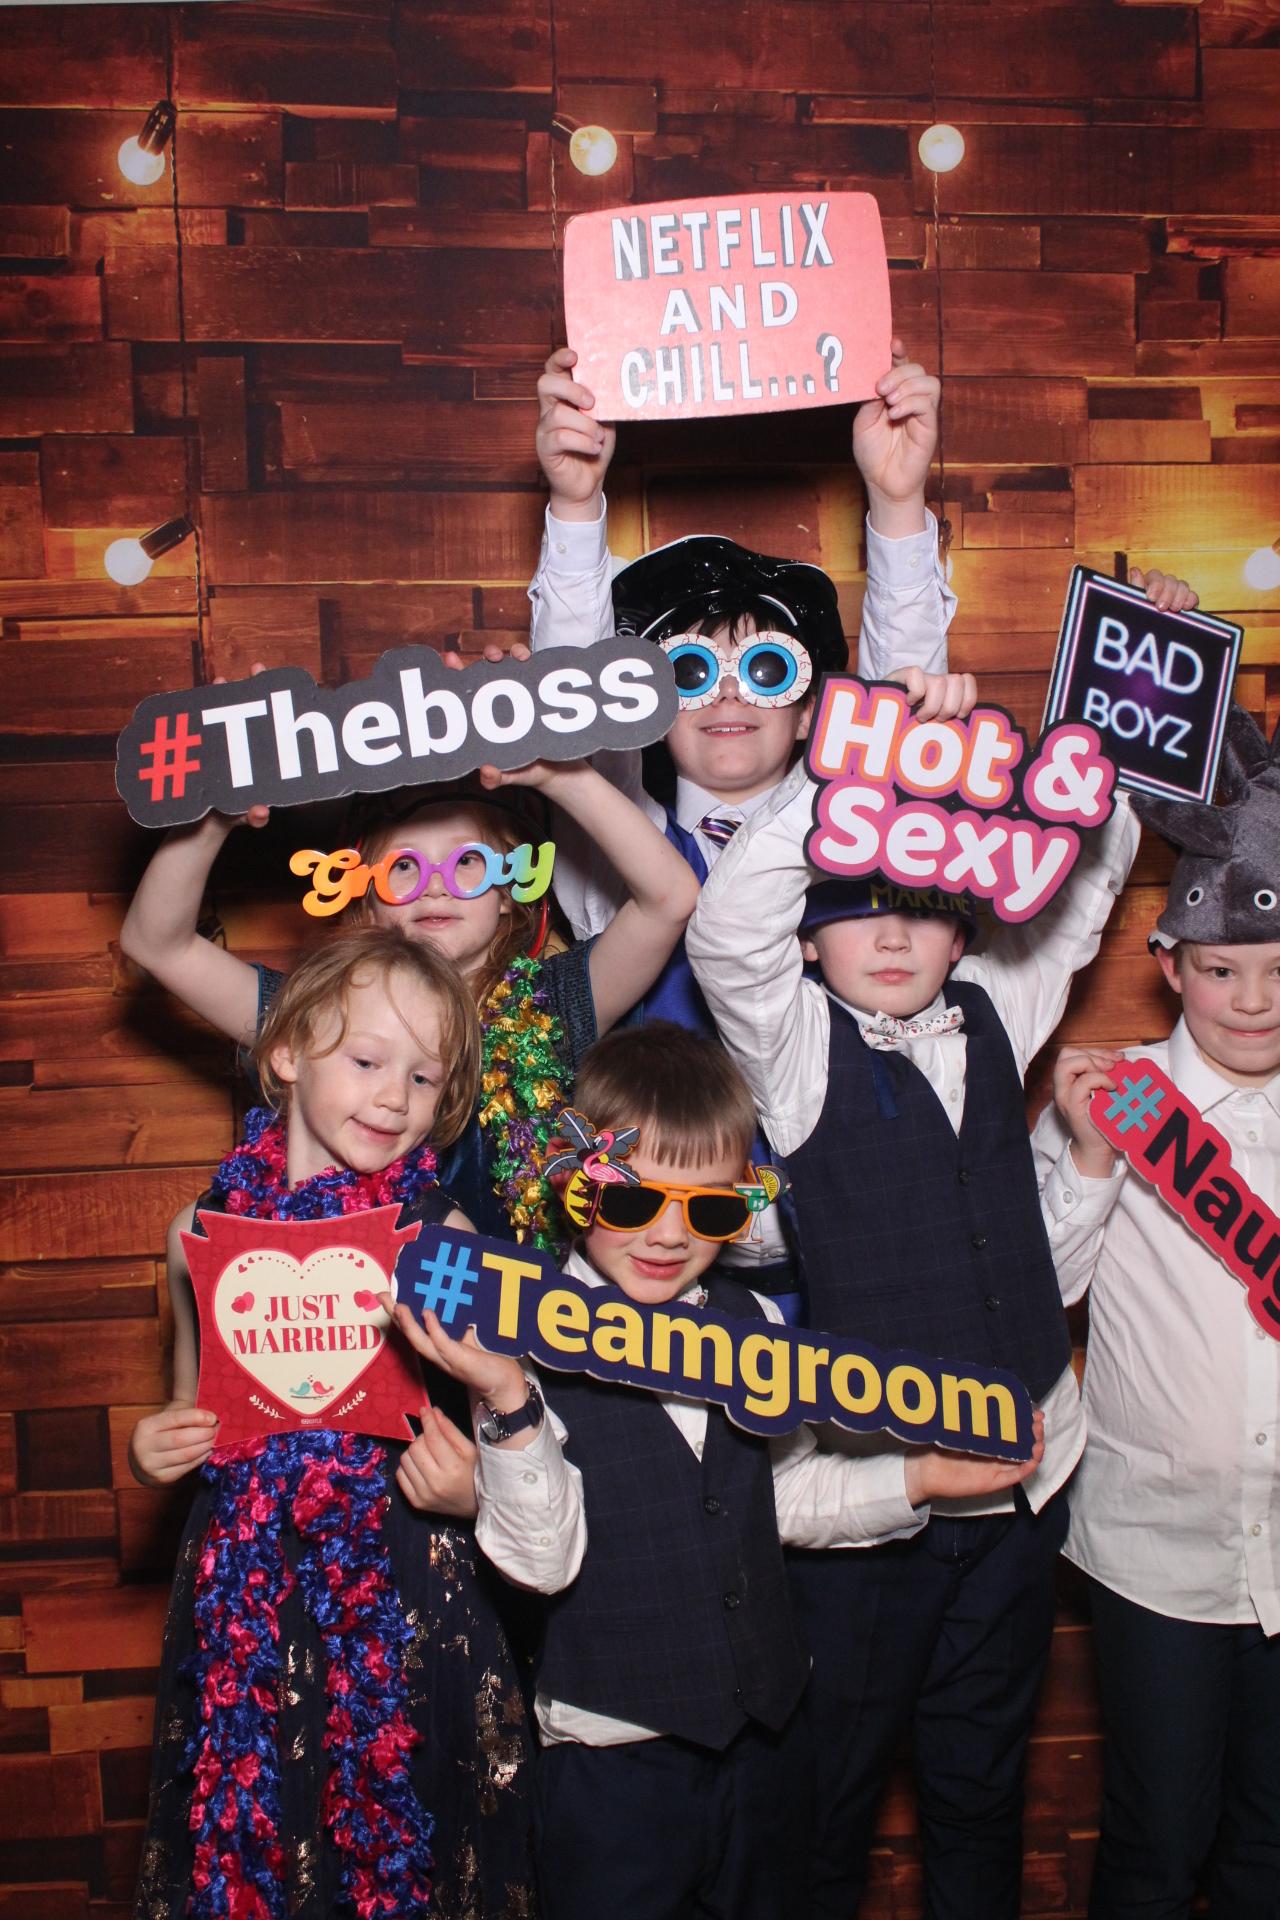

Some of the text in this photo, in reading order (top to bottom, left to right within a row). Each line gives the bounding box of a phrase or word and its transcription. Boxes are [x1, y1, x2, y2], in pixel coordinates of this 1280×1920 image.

[611, 202, 834, 280] NETFLIX
[659, 281, 799, 336] AND
[620, 333, 844, 409] CHILL...?
[1093, 616, 1205, 695] BAD
[138, 657, 660, 801] #Theboss
[820, 690, 1104, 817] Hot &
[1082, 687, 1193, 759] BOYZ
[819, 786, 1069, 913] Sexy
[232, 1324, 382, 1355] MARRIED
[264, 1294, 340, 1322] JUST
[413, 1241, 1019, 1444] #Teamgroom
